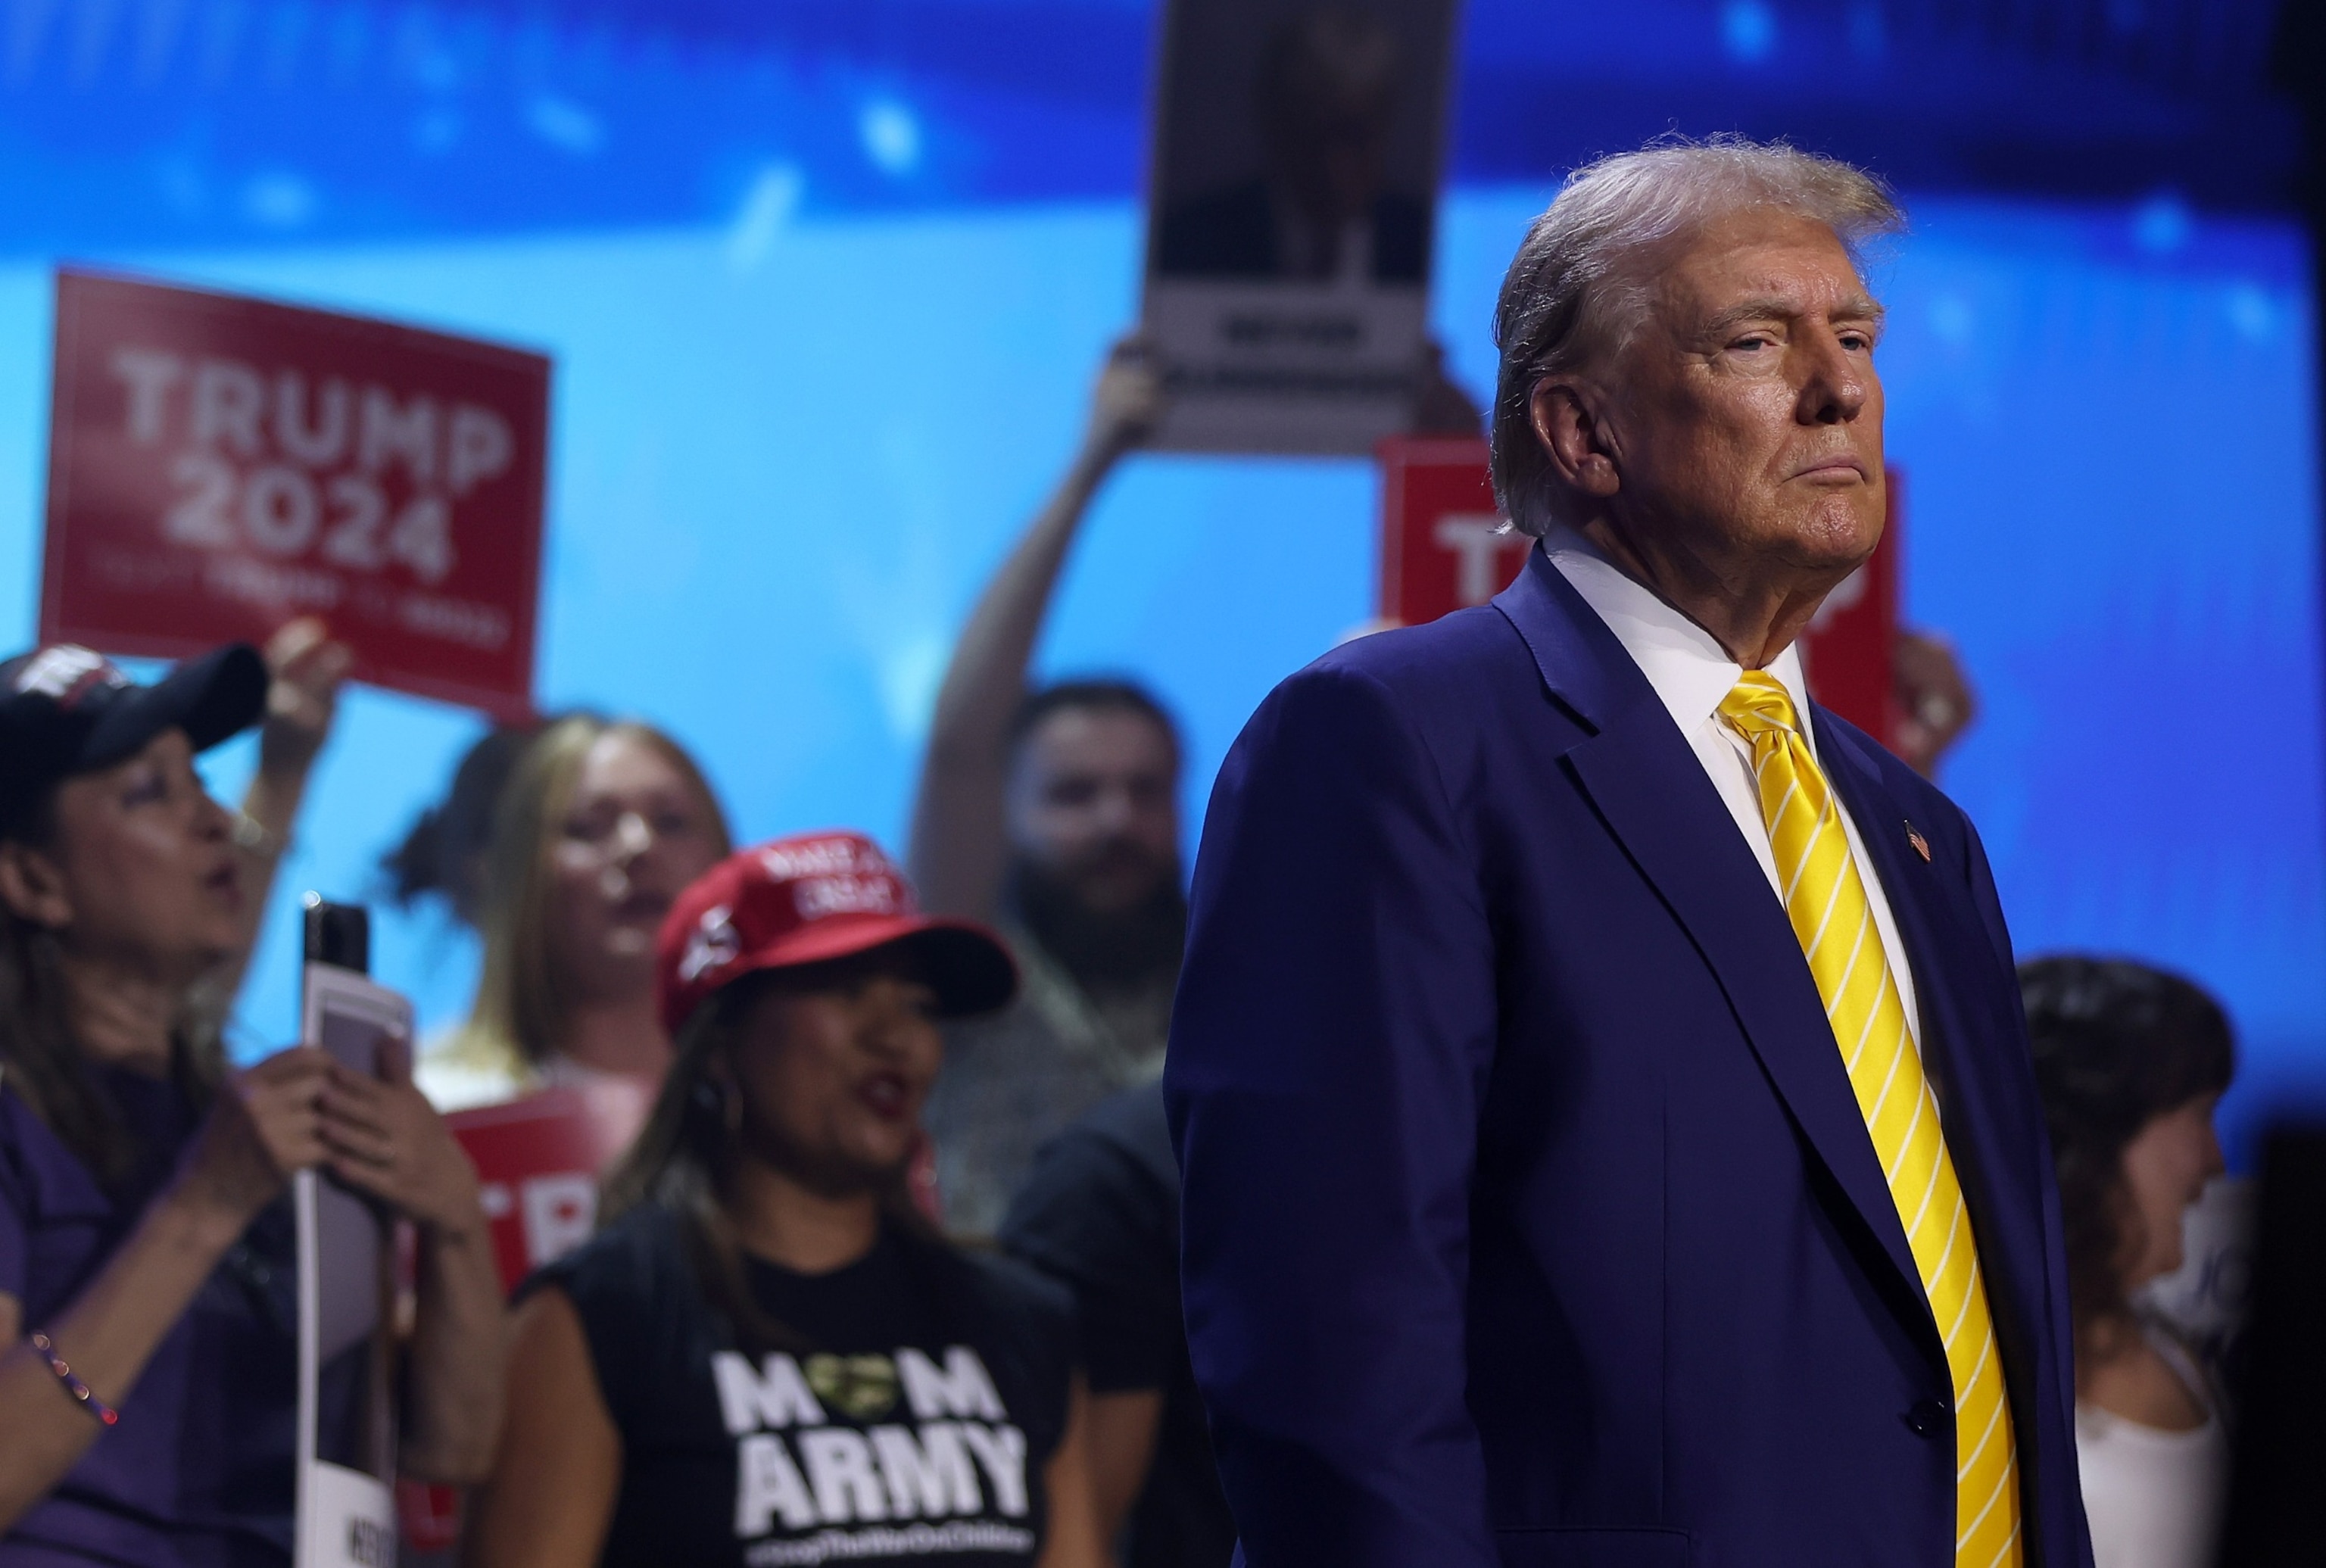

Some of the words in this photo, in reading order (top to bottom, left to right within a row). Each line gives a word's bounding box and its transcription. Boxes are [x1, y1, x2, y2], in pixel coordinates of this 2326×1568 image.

[111, 346, 516, 498] TRUMP
[161, 454, 454, 584] 2024
[735, 1421, 1030, 1538] ARMY
